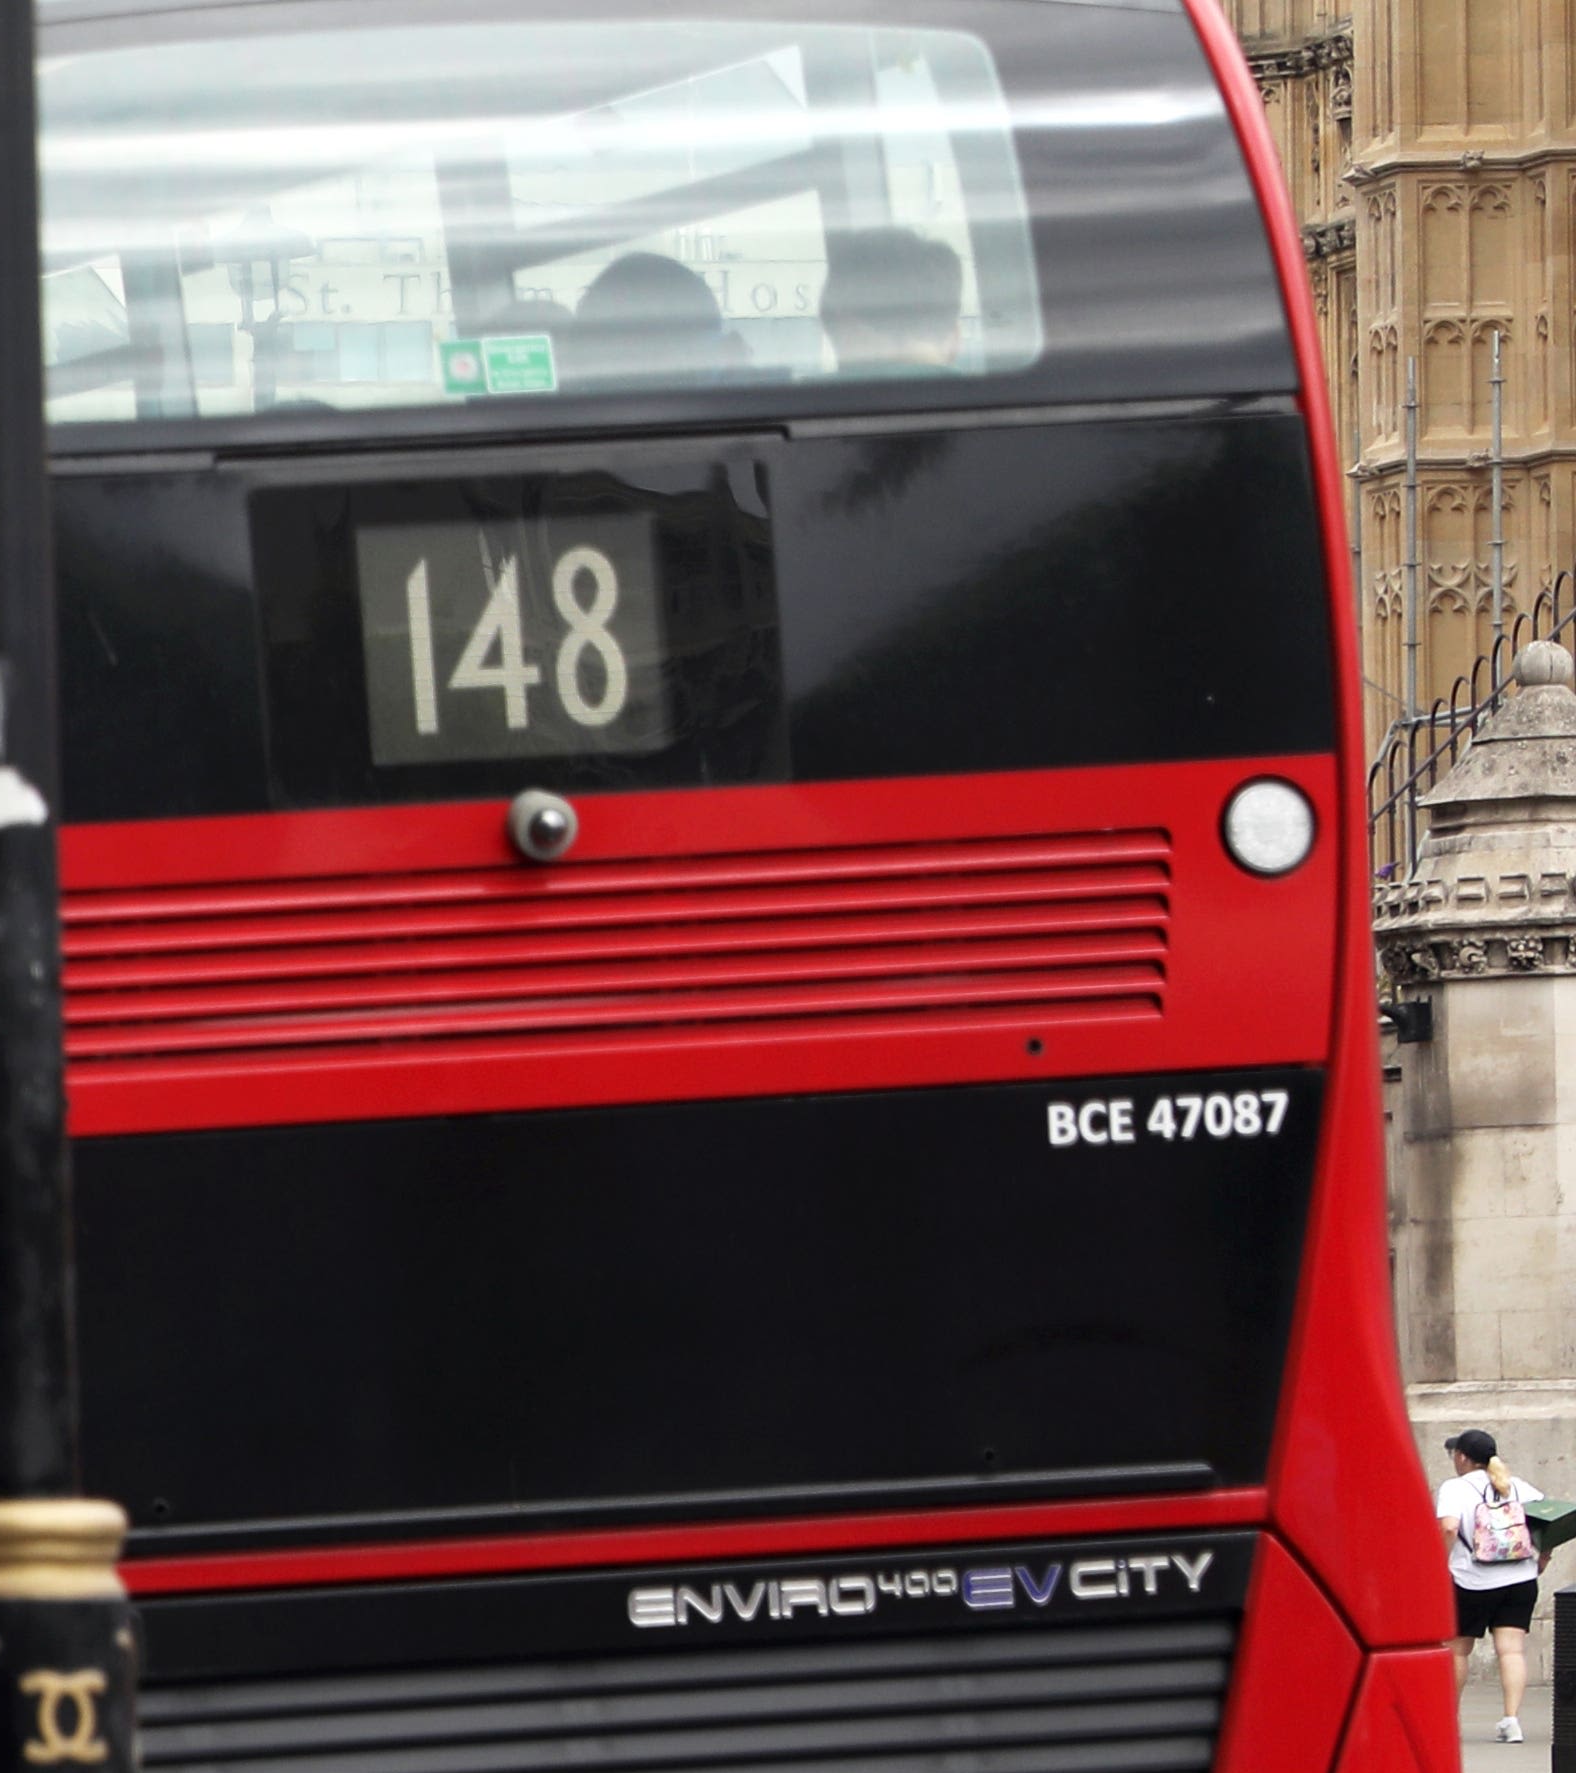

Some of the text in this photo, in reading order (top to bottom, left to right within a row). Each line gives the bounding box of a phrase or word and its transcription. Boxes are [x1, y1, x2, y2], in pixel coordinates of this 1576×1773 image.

[406, 547, 628, 735] 148
[1048, 1090, 1289, 1146] BCE 47087
